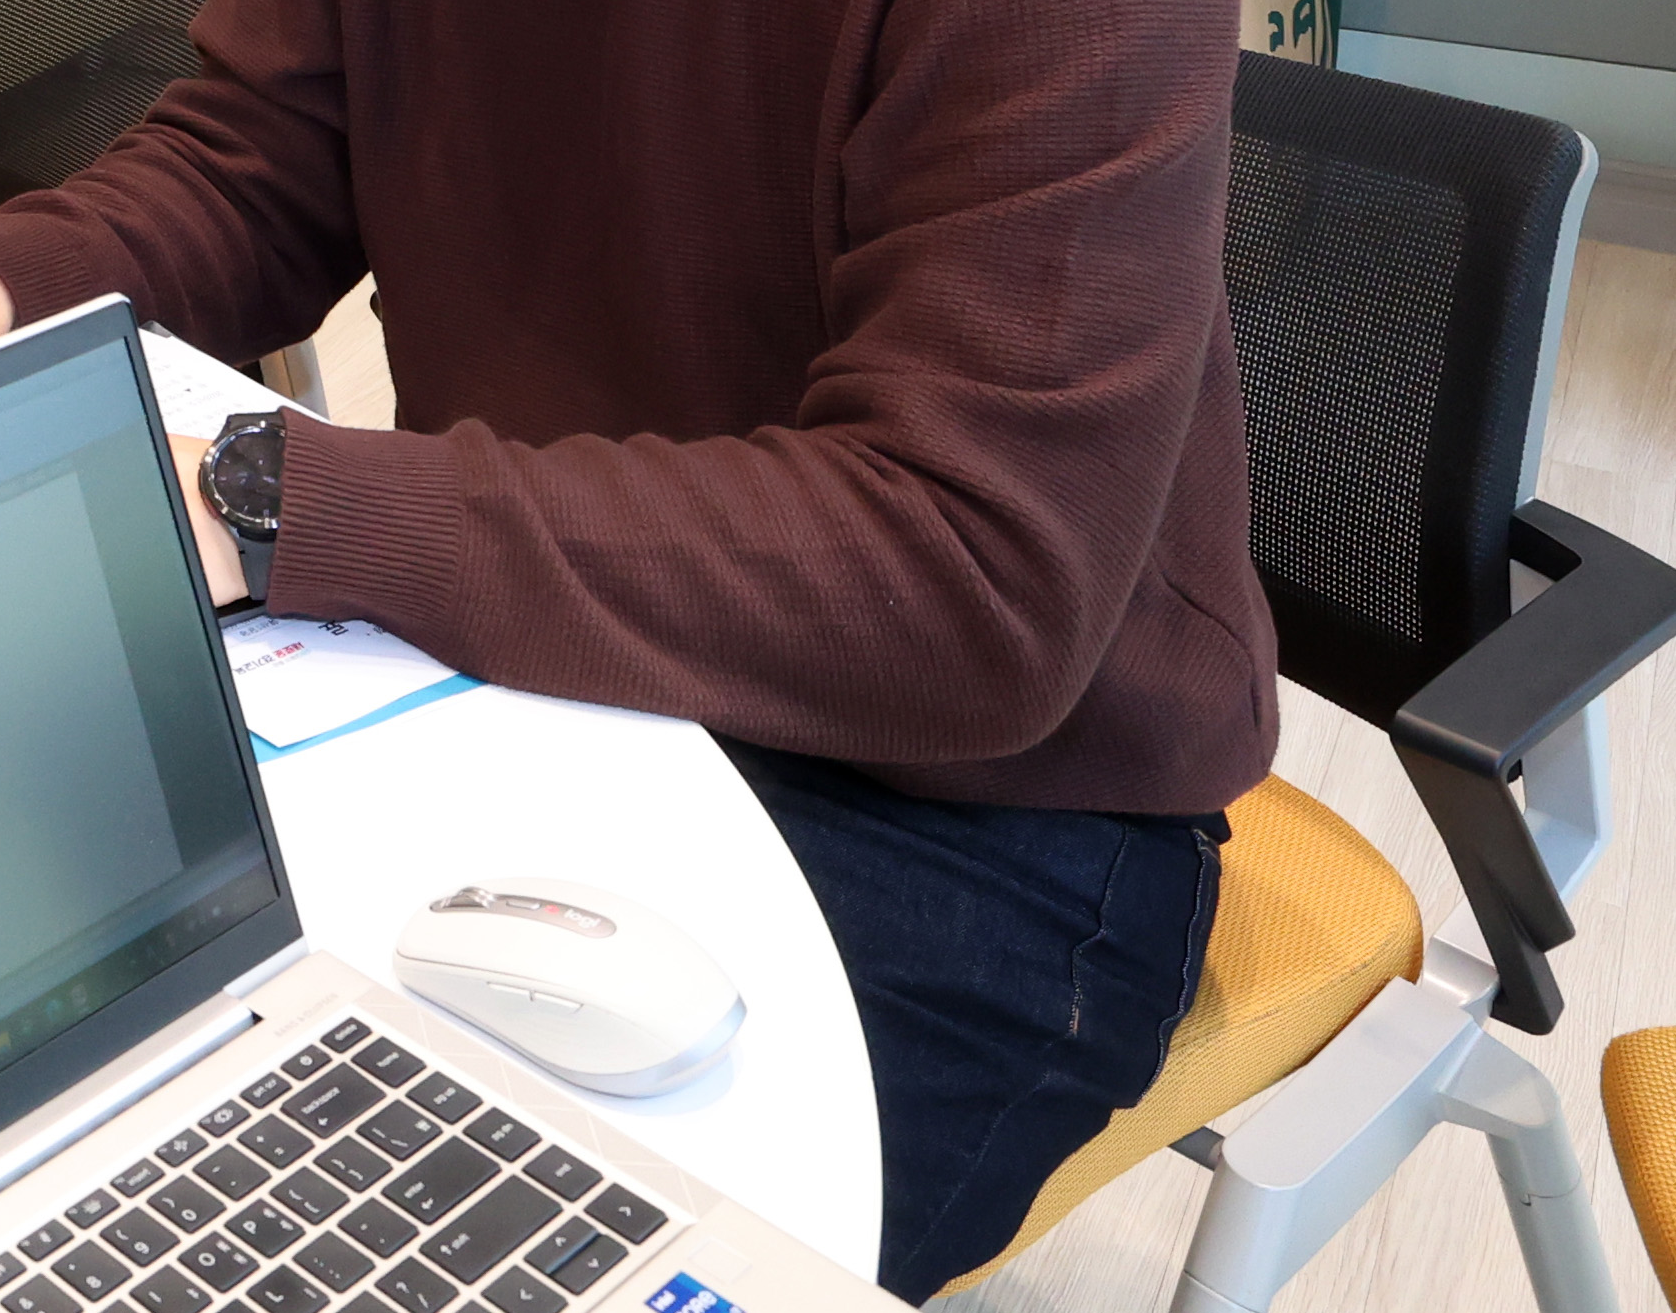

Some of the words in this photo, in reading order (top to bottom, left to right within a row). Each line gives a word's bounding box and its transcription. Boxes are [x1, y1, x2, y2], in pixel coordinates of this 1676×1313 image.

[565, 908, 601, 929] logi
[300, 1086, 341, 1115] backspace
[242, 1219, 257, 1235] P
